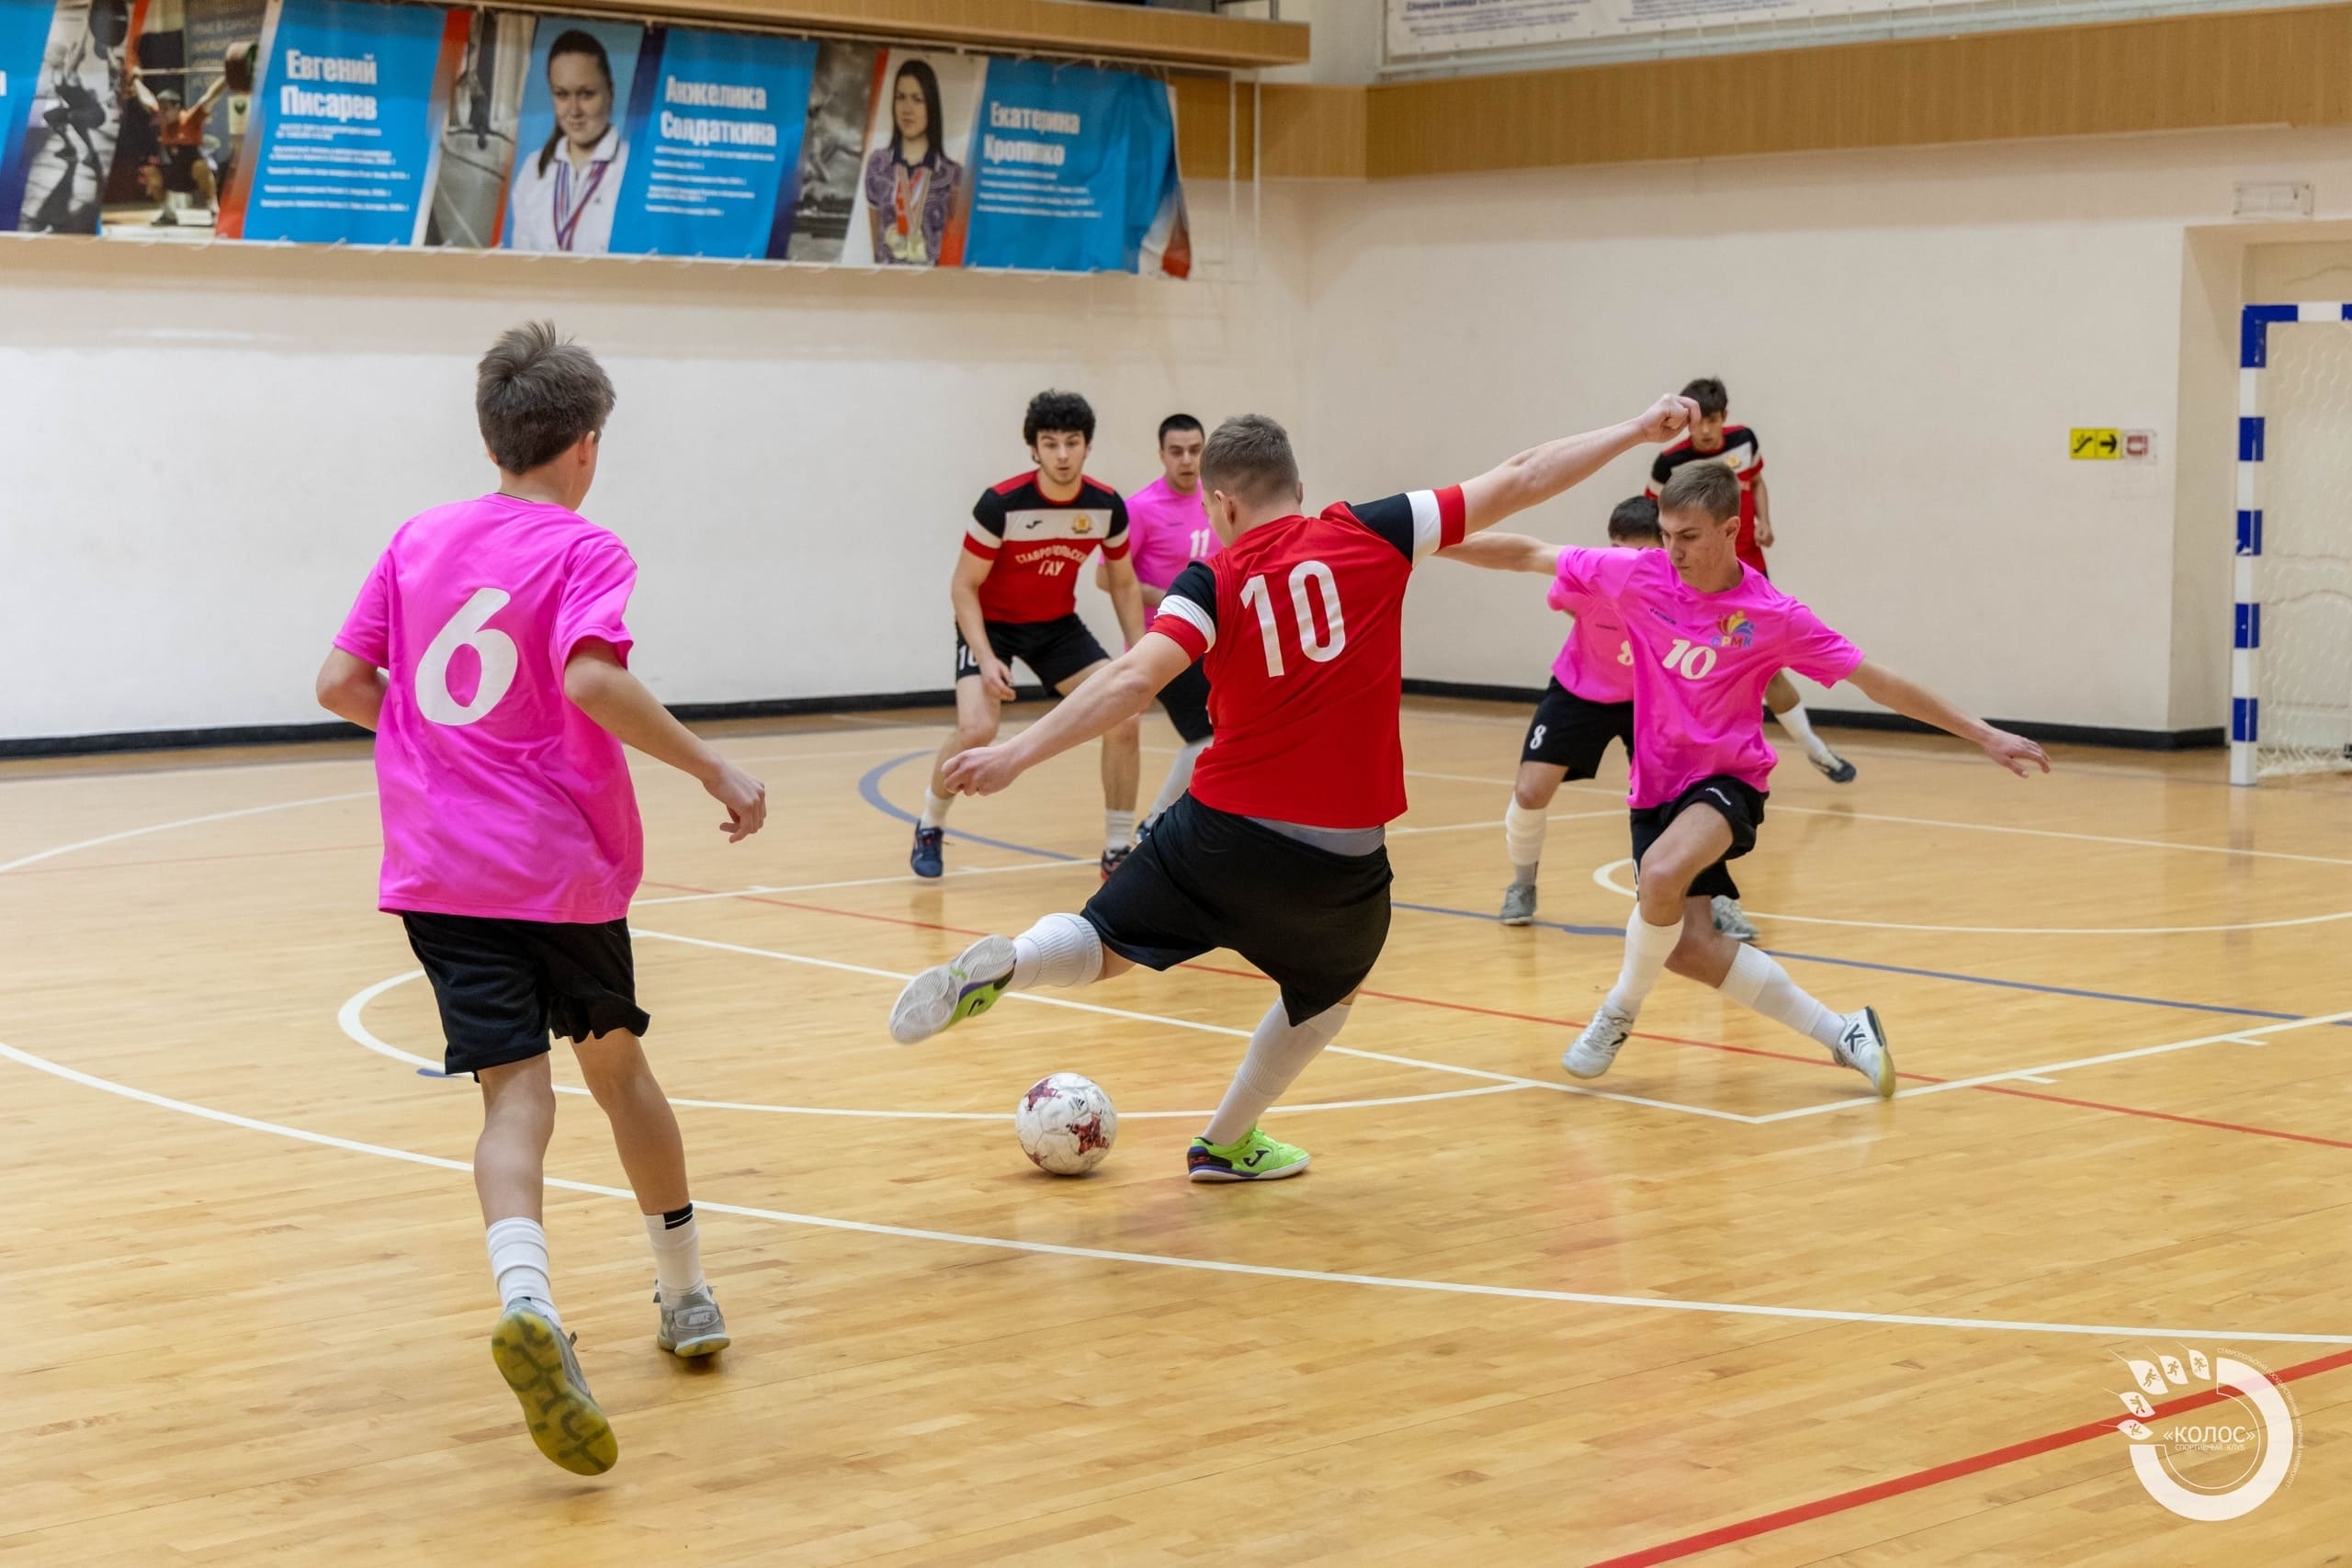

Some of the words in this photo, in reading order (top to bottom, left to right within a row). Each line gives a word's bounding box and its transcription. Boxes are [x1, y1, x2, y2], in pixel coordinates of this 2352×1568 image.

[286, 49, 378, 85] Евгений
[280, 85, 378, 122] Писарев
[665, 75, 767, 110] Анжелика
[990, 102, 1080, 134] Екатерина
[1190, 528, 1211, 559] 11
[1038, 559, 1066, 576] ГАУ
[1240, 559, 1346, 678] 10
[414, 587, 519, 727] 6
[1662, 638, 1717, 680] 10
[1530, 724, 1547, 750] 8
